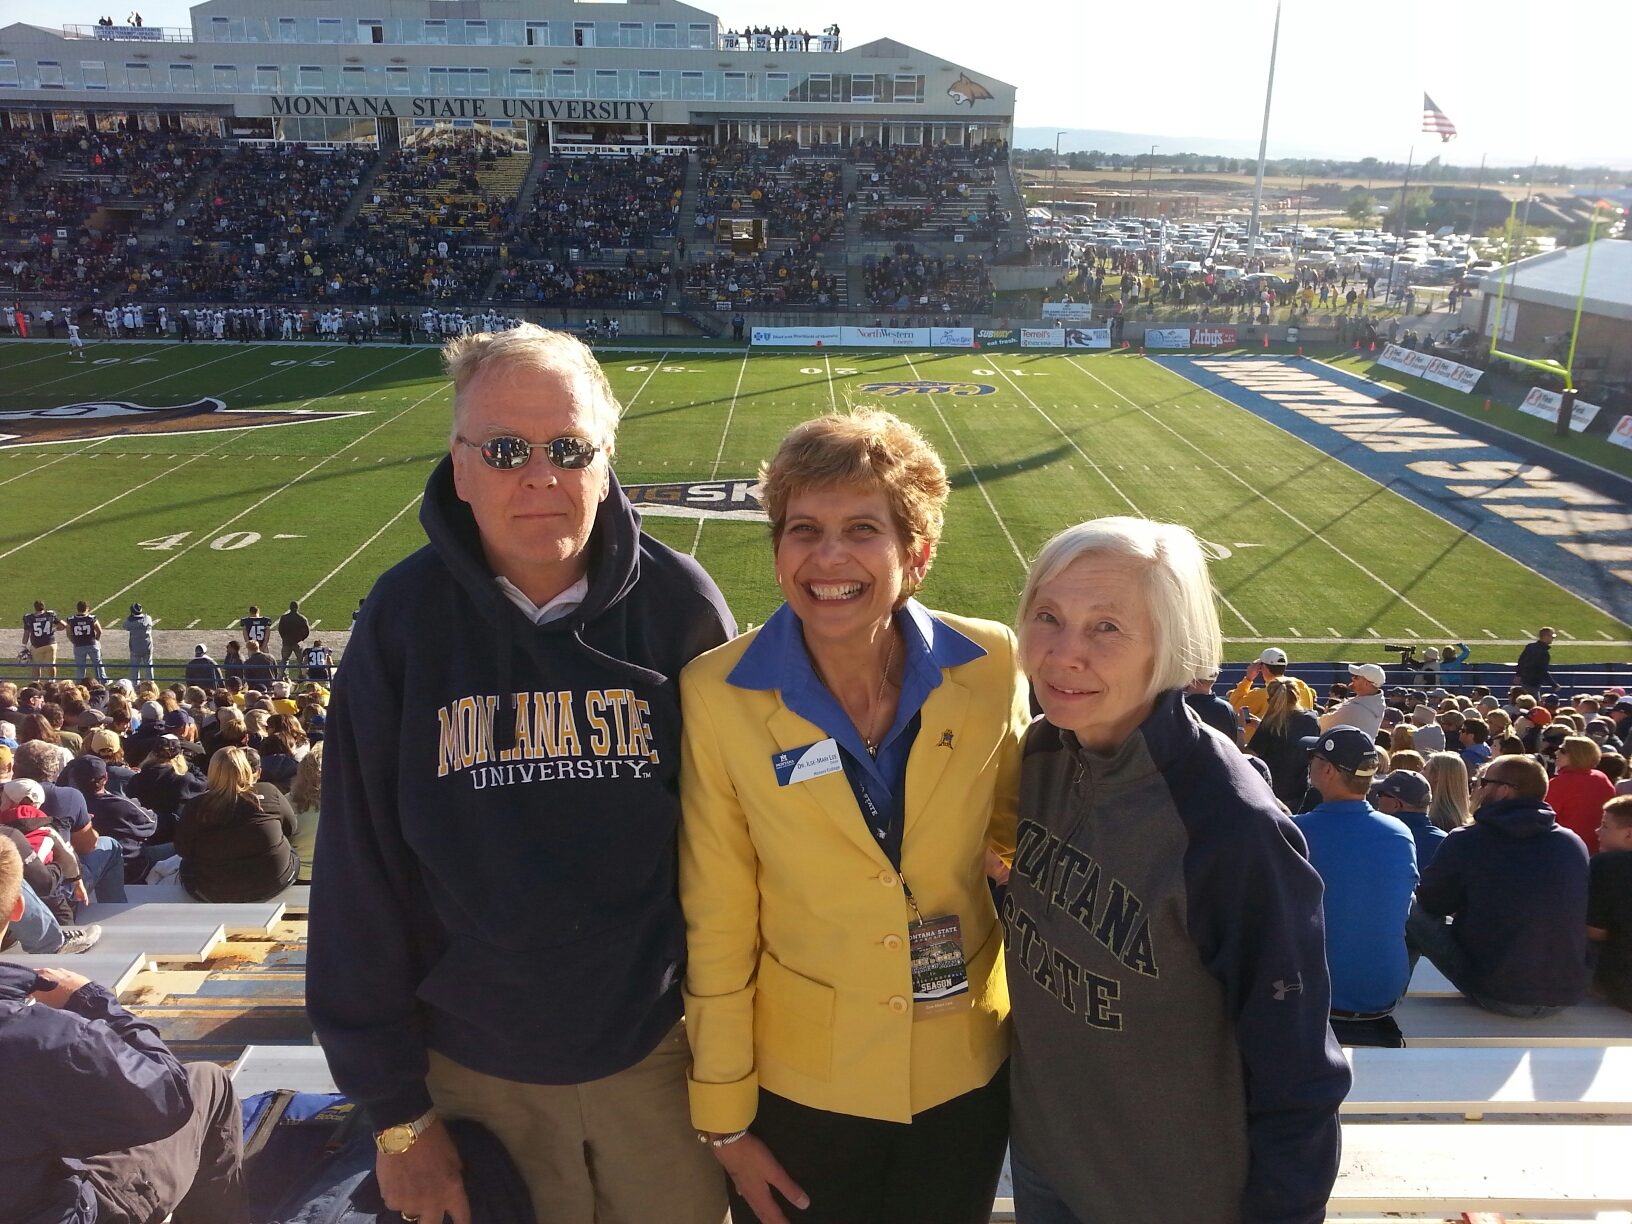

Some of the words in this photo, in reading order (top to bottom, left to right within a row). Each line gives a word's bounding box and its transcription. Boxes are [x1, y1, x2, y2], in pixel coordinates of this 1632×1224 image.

[725, 39, 734, 48] 78
[757, 39, 766, 48] 52
[789, 40, 798, 49] 21
[823, 41, 832, 49] 77
[270, 96, 396, 116] MONTANA
[412, 98, 487, 117] STATE
[501, 100, 654, 121] UNIVERSITY
[857, 328, 914, 339] NorthWestern
[977, 329, 1013, 338] SUBWAY
[1022, 329, 1051, 338] Terrell's
[1191, 328, 1224, 348] Arby's
[136, 531, 262, 551] 40
[33, 620, 52, 637] 54
[249, 625, 265, 641] 45
[308, 651, 325, 666] 30
[437, 690, 582, 778] MONANA
[470, 760, 648, 790] UNIVERSITY
[1015, 817, 1160, 980] ONTANA
[937, 926, 958, 935] STATE
[1001, 891, 1123, 1032] STATE
[921, 978, 953, 992] SEASON
